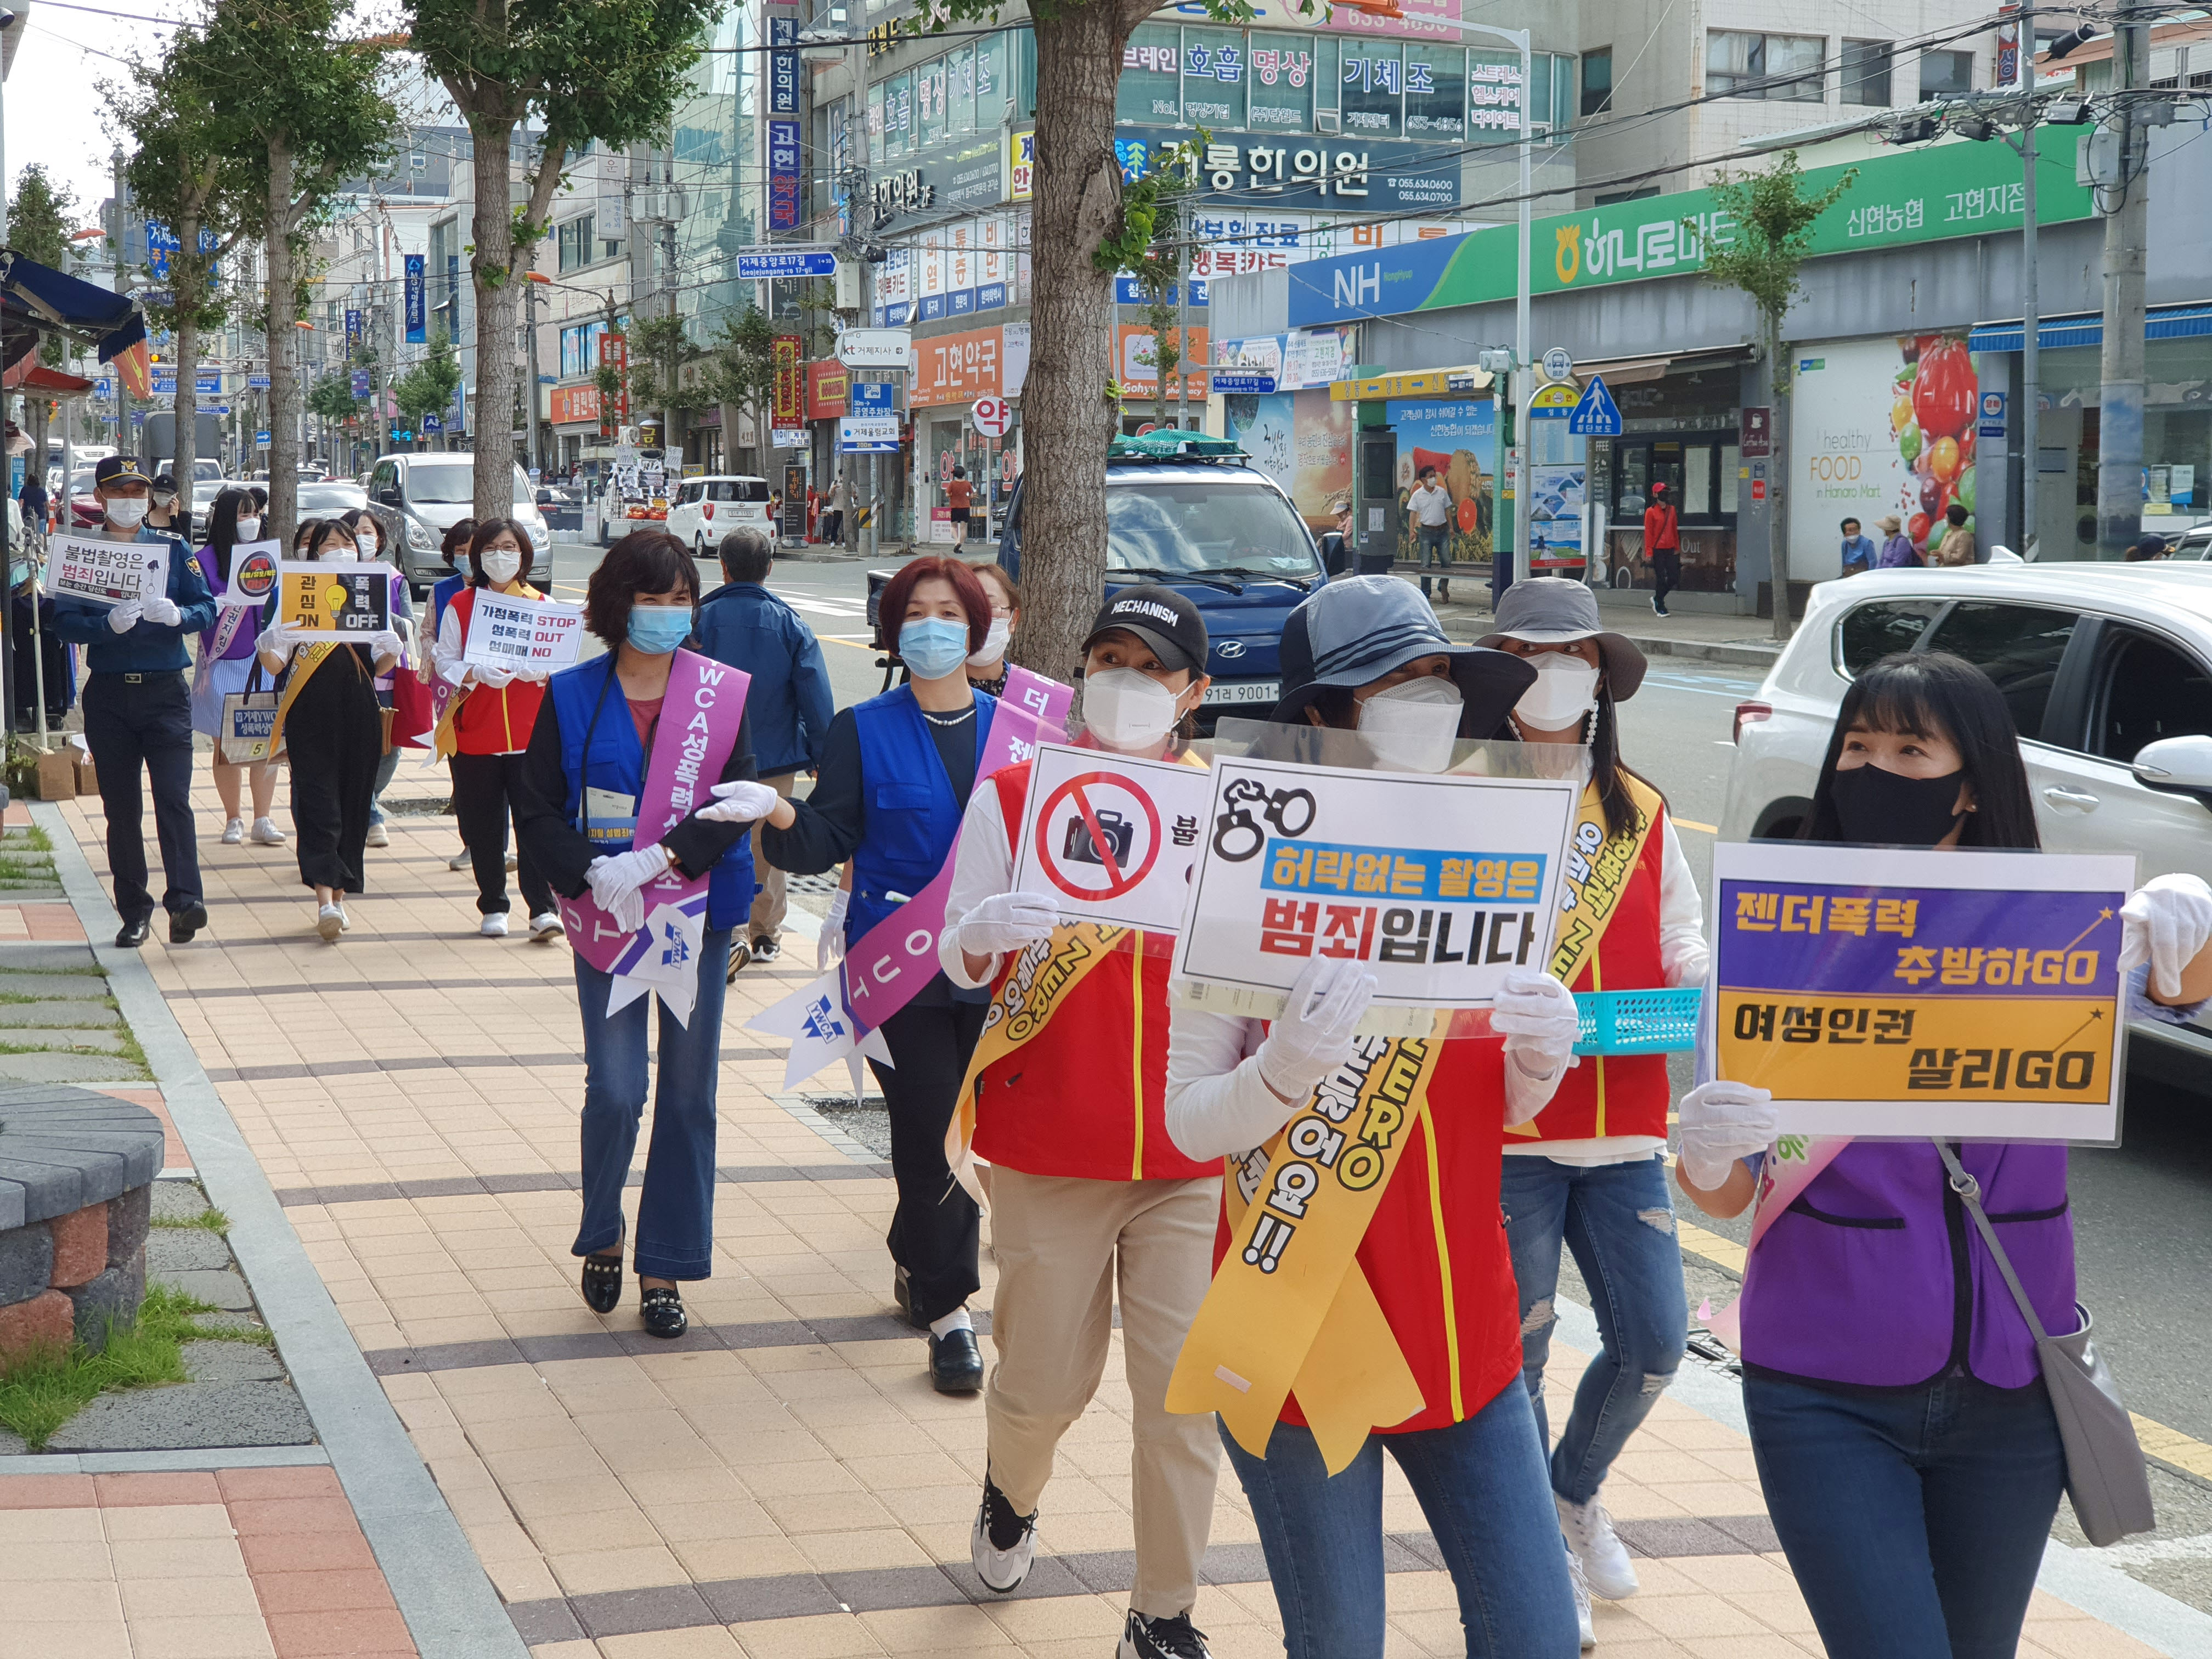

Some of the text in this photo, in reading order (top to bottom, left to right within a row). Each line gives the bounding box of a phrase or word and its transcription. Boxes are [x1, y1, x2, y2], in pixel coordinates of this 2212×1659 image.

[1184, 43, 1243, 82] 호흡
[1252, 49, 1312, 87] 명상
[1344, 58, 1434, 95] 기체조
[1471, 64, 1522, 84] 스트레스
[885, 87, 909, 133] 호흡
[919, 71, 945, 121] 명상
[949, 53, 991, 107] 기체조
[1471, 85, 1521, 107] 헬스케어
[1185, 102, 1229, 119] 명상기업
[1347, 112, 1390, 128] 거제센터
[1406, 115, 1463, 132] 633-4856
[1471, 110, 1521, 129] 다이어트
[1398, 179, 1453, 190] 055.634.0600
[1398, 191, 1453, 202] 055.634.0700
[1847, 198, 1924, 238] 신현농협
[740, 256, 805, 267] 거제중앙로17길
[742, 266, 813, 276] Geojejungang-ro 17-gil
[1334, 262, 1380, 308] NH
[857, 346, 891, 356] 거제지사
[934, 339, 996, 387] 고현약국
[1166, 387, 1202, 396] phaacy
[854, 407, 891, 417] 공영주차장
[977, 400, 1009, 435] 약
[1400, 405, 1478, 421] 고객님이 잠시 쉬어갈 수 있는
[1430, 423, 1463, 437] 신현농협이
[1577, 425, 1612, 433] 횡단보도
[1824, 430, 1872, 452] healthy
[1810, 456, 1862, 481] FOOD
[1825, 486, 1858, 498] Hanaro
[1860, 485, 1881, 498] Mart
[64, 544, 144, 570] 불법촬영은
[59, 579, 108, 595] 보는 순간 당신도
[61, 563, 142, 591] 범죄입니다
[300, 576, 317, 610] 관심
[355, 576, 370, 610] 폭력
[295, 614, 379, 628] ON OFF
[482, 605, 577, 628] 가정폭력 STOP
[1111, 600, 1179, 627] MECHANISM
[492, 624, 565, 643] 성폭력 OUT
[489, 640, 552, 657] 성매매 NO
[1205, 686, 1271, 702] 91러 9001
[253, 743, 263, 754] 5
[1171, 815, 1199, 846] 불
[1272, 846, 1538, 899] 허락없는 촬영은
[1736, 892, 1920, 938] 젠더폭력
[1260, 897, 1535, 966] 범죄입니다
[671, 930, 682, 967] YWCA
[1893, 945, 2100, 986] 추방하GO
[809, 1002, 835, 1040] YWCA
[1734, 1003, 1917, 1045] 여성인권
